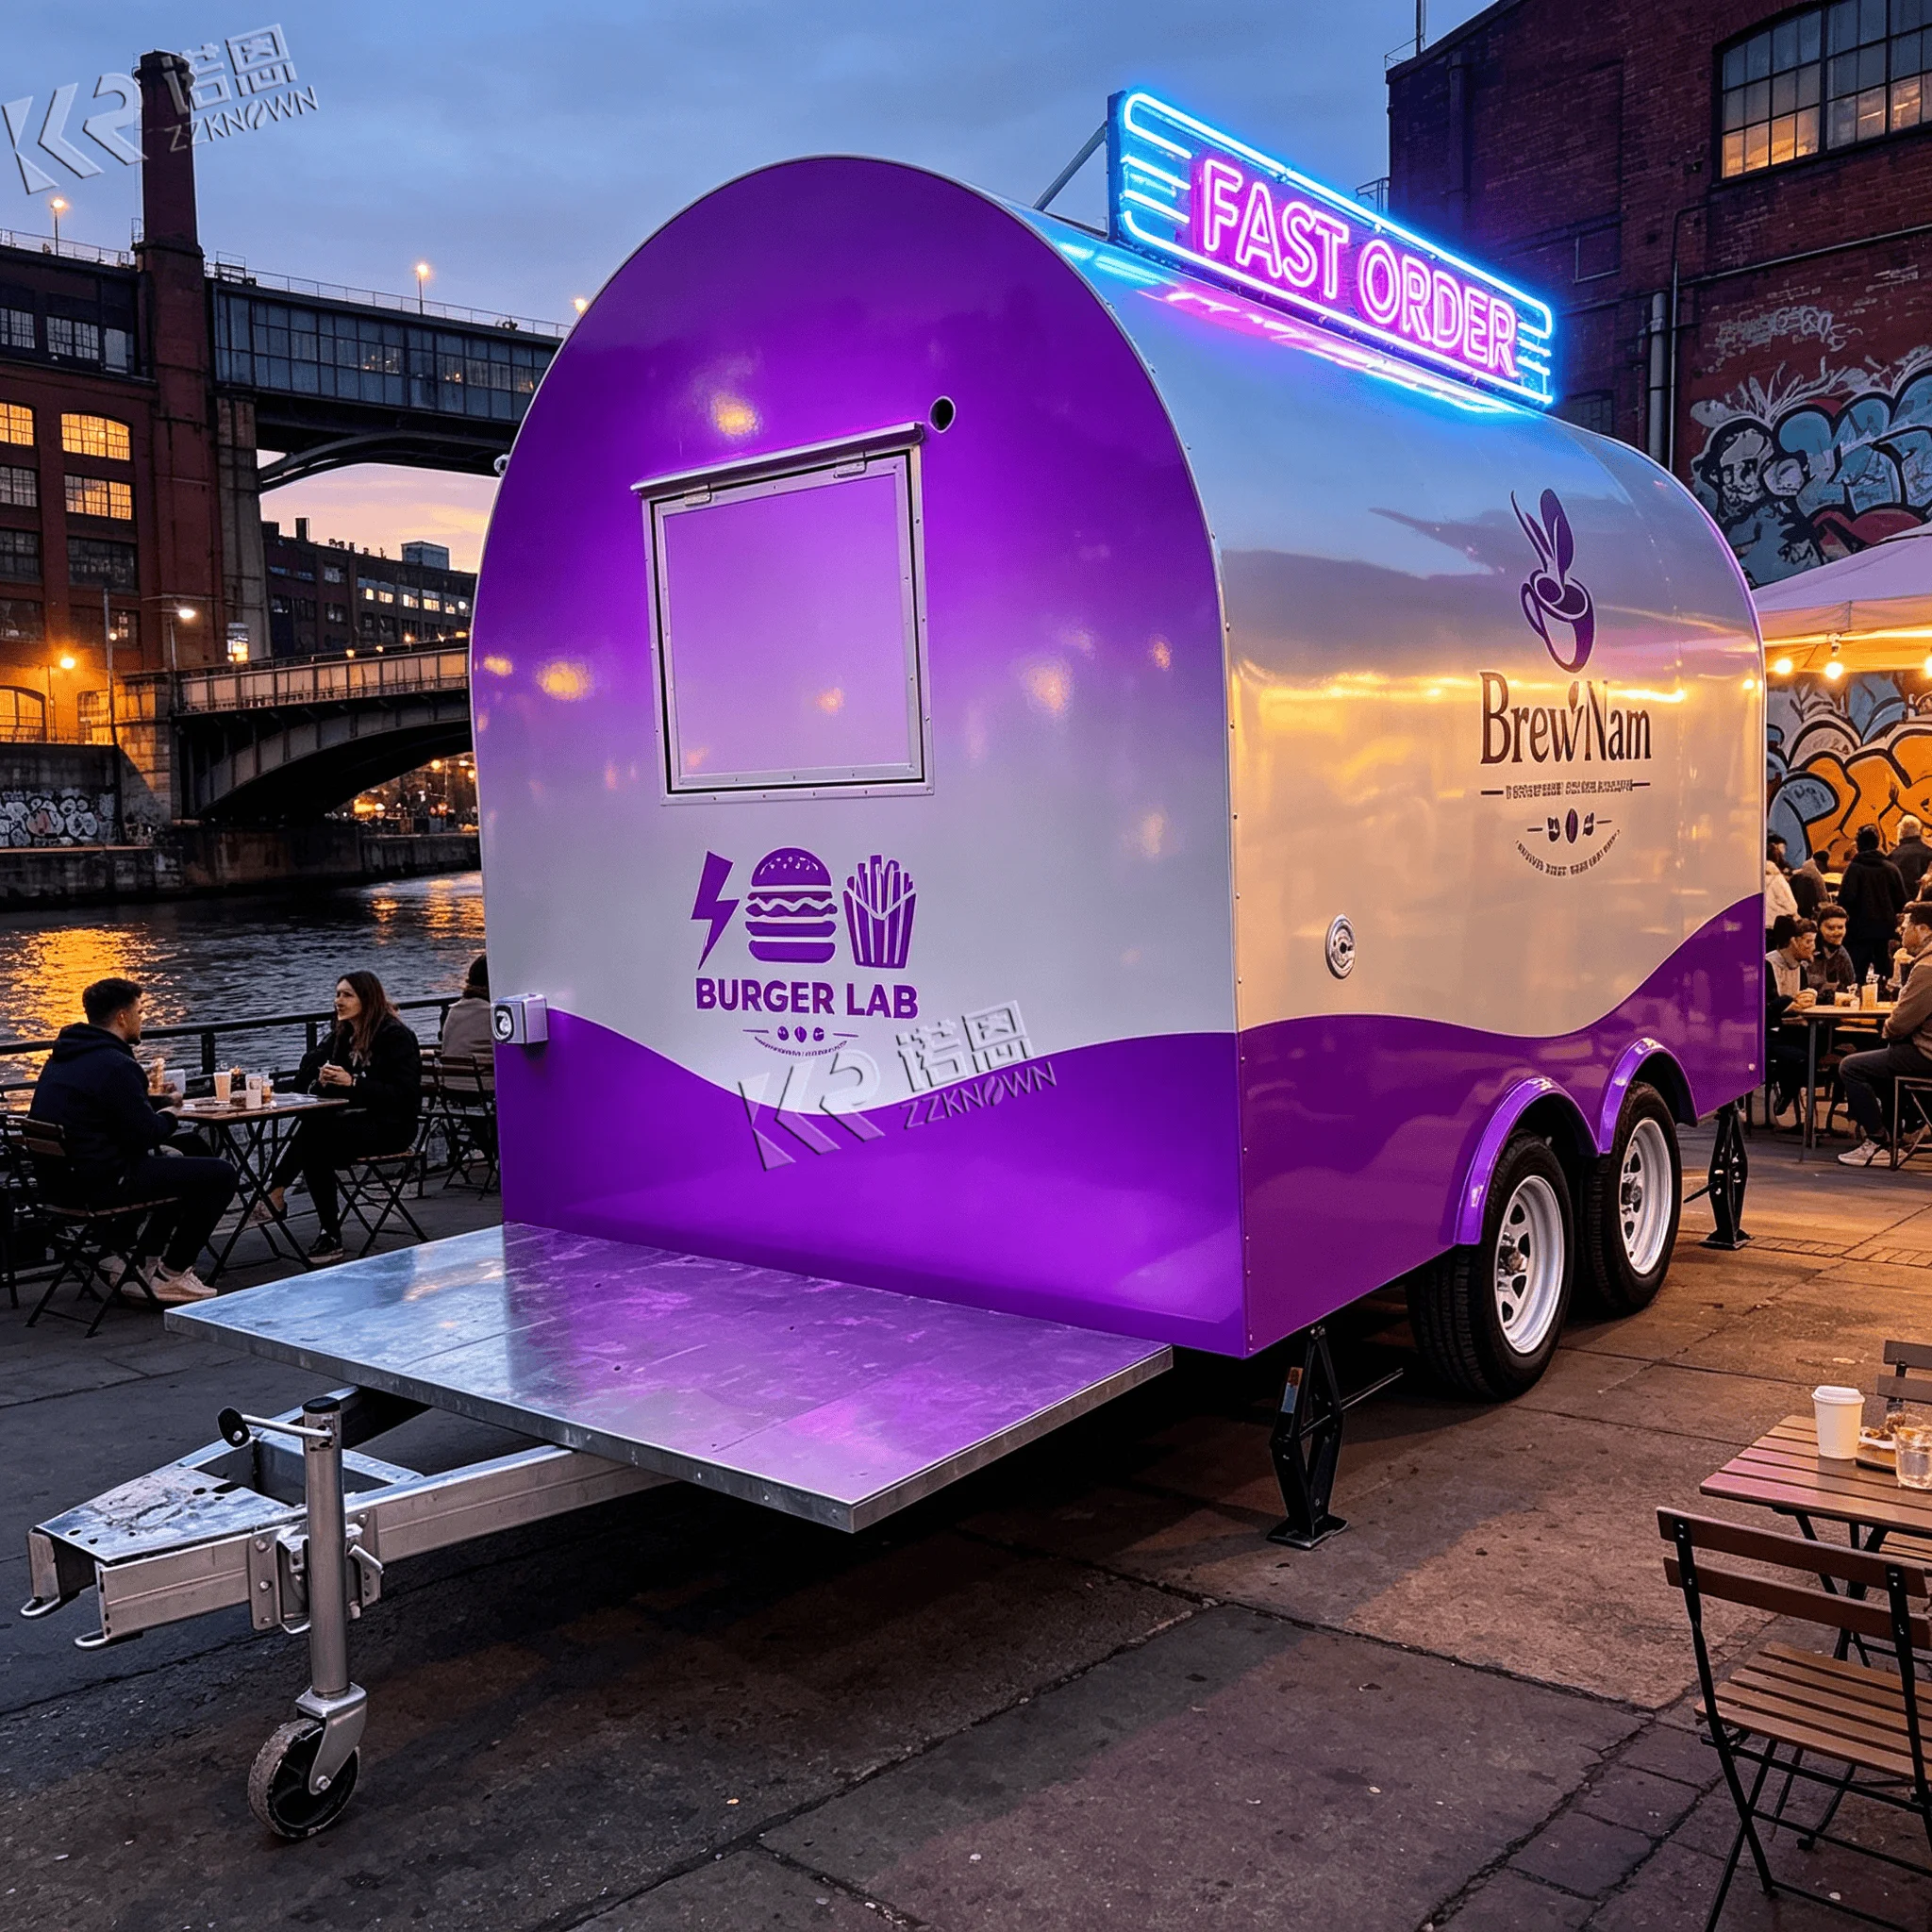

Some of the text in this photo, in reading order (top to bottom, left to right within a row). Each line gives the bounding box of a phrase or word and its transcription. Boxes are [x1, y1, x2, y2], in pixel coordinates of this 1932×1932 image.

[1203, 158, 1520, 377] FAST ORDER
[695, 977, 919, 1020] BURGER LAB
